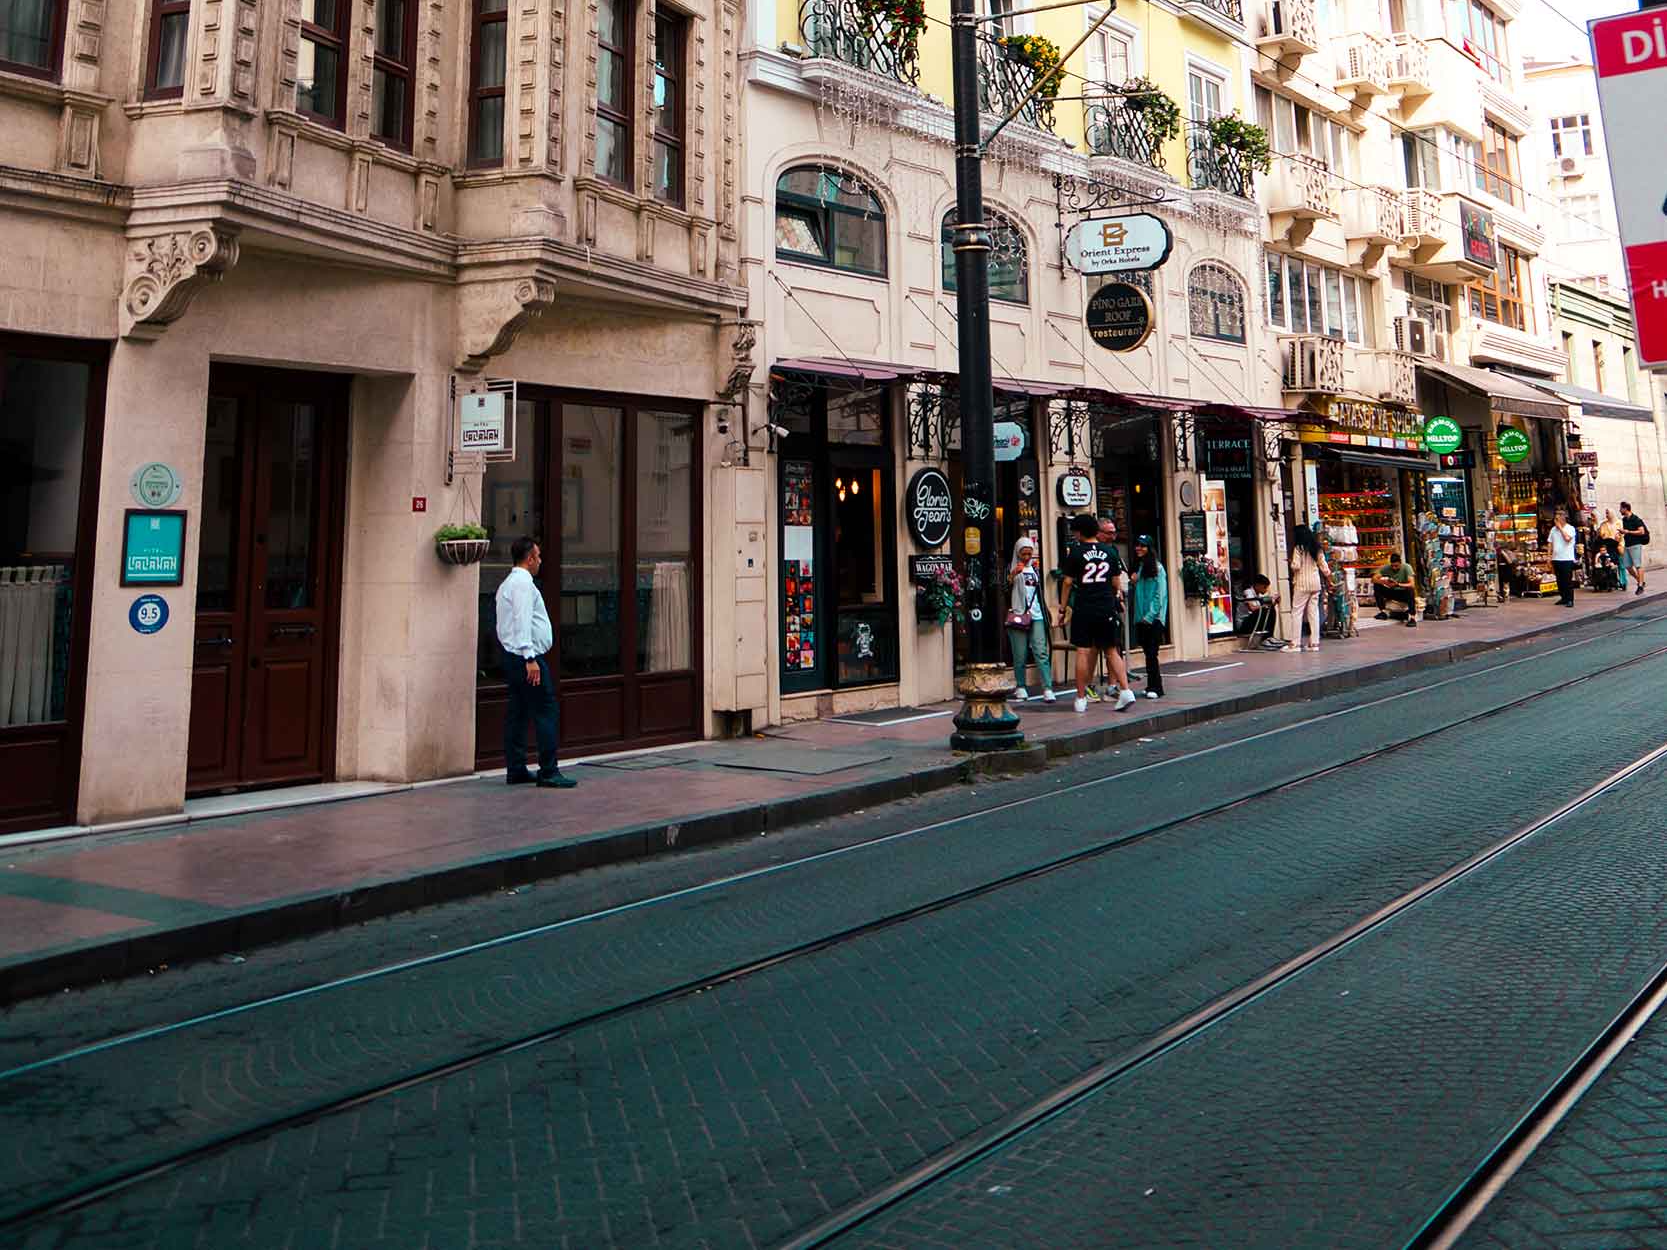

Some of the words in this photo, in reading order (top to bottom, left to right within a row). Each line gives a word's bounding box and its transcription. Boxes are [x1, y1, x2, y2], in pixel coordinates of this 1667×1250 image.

[1080, 249, 1112, 258] Orient
[1114, 246, 1150, 257] Express
[1093, 328, 1143, 338] restaurant
[1427, 418, 1458, 434] HARMONY
[1206, 439, 1251, 449] TERRACE
[1499, 431, 1526, 445] HARMONY
[917, 485, 949, 507] Gloria
[913, 507, 952, 532] Jean's
[915, 563, 940, 573] WAGON
[1082, 562, 1110, 583] 22
[140, 607, 158, 620] 9.5
